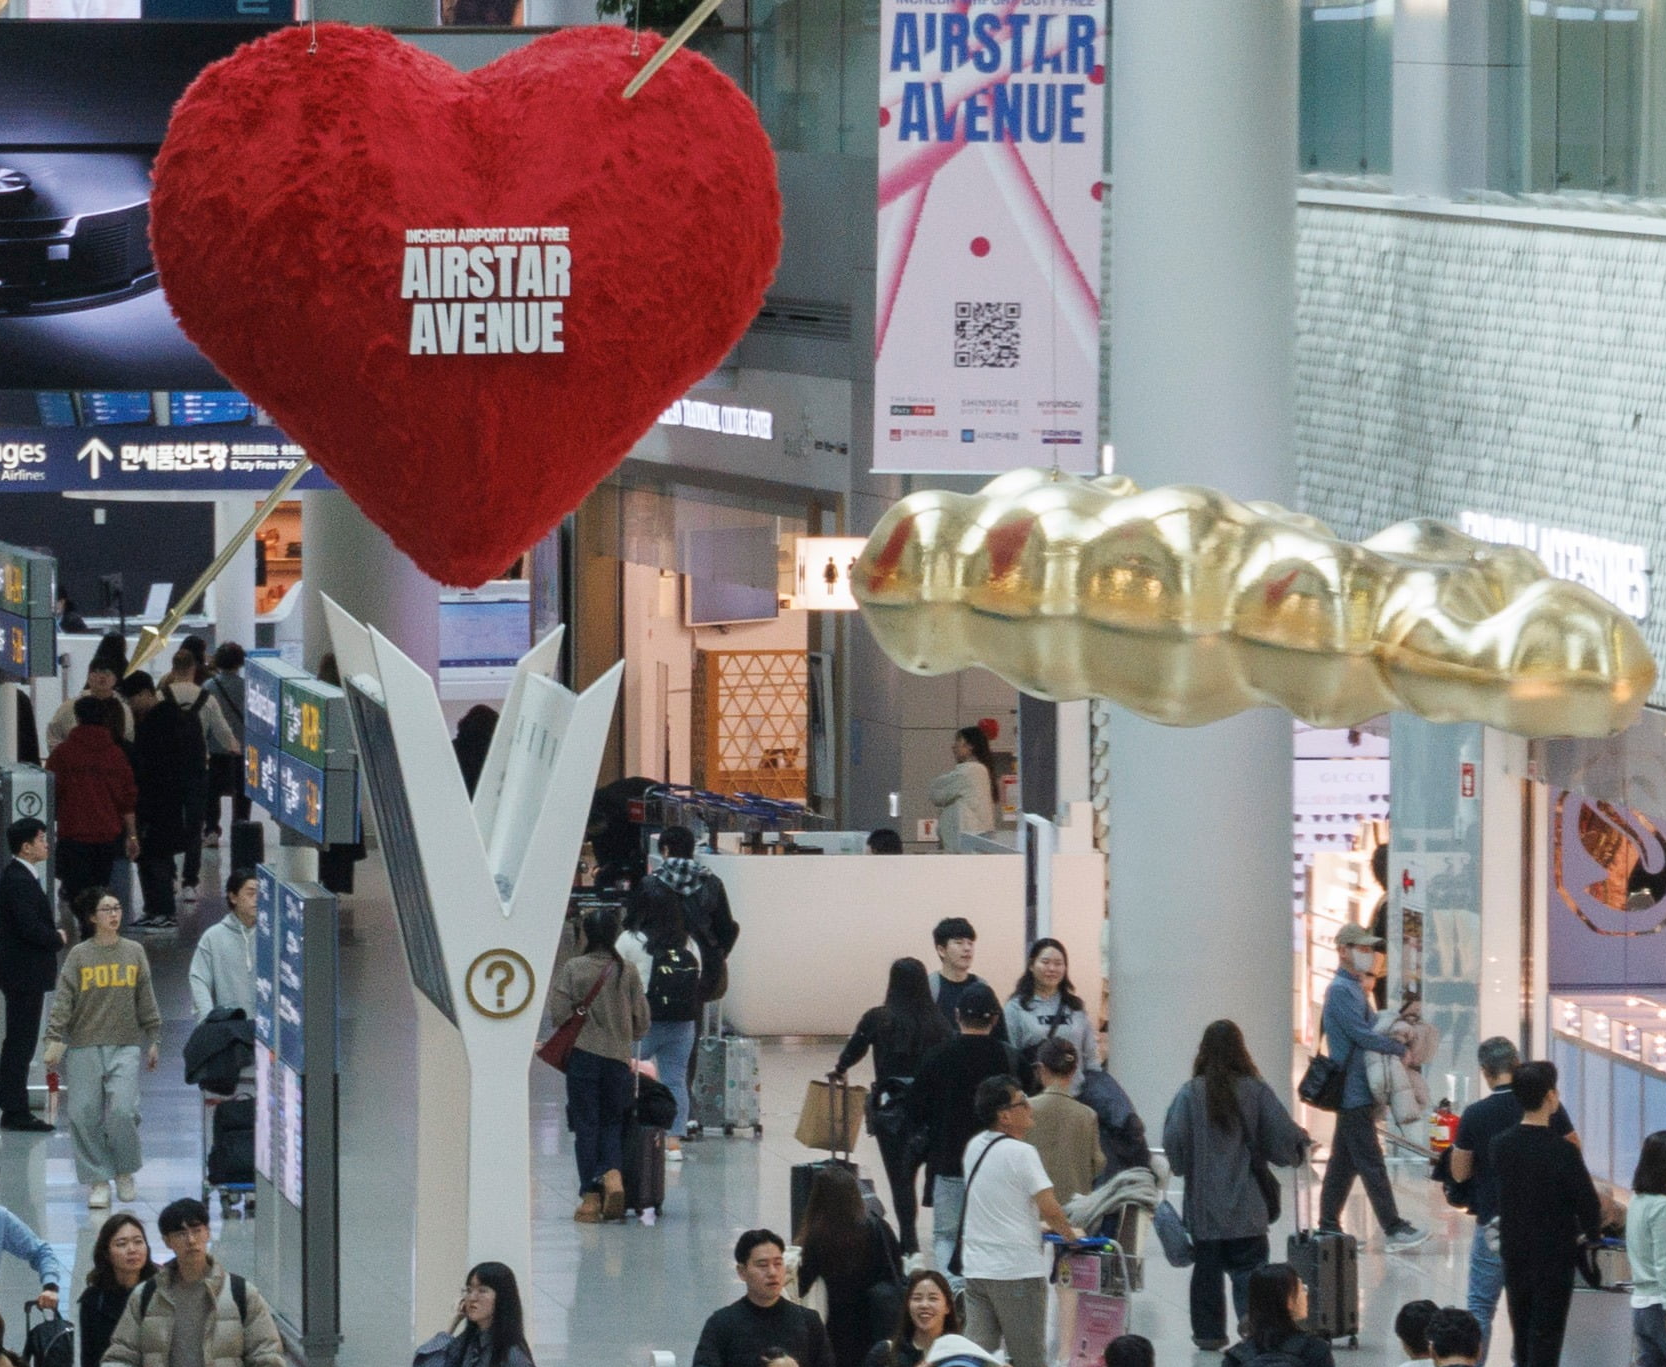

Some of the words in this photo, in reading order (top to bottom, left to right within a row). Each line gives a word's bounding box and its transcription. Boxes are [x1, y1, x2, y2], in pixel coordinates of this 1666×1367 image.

[889, 12, 1096, 74] AIRSTAR
[898, 82, 1086, 143] AVENUE
[405, 228, 456, 244] INCHEON
[457, 227, 507, 243] AIRPORT
[508, 227, 539, 242] DUTY
[540, 226, 570, 242] FREE
[400, 244, 572, 299] AIRSTAR
[409, 301, 565, 355] AVENUE
[120, 443, 229, 471] 면세품인도장
[230, 460, 254, 472] Duty
[255, 460, 277, 471] Free
[0, 469, 46, 482] Airlines
[80, 963, 137, 991] POLO
